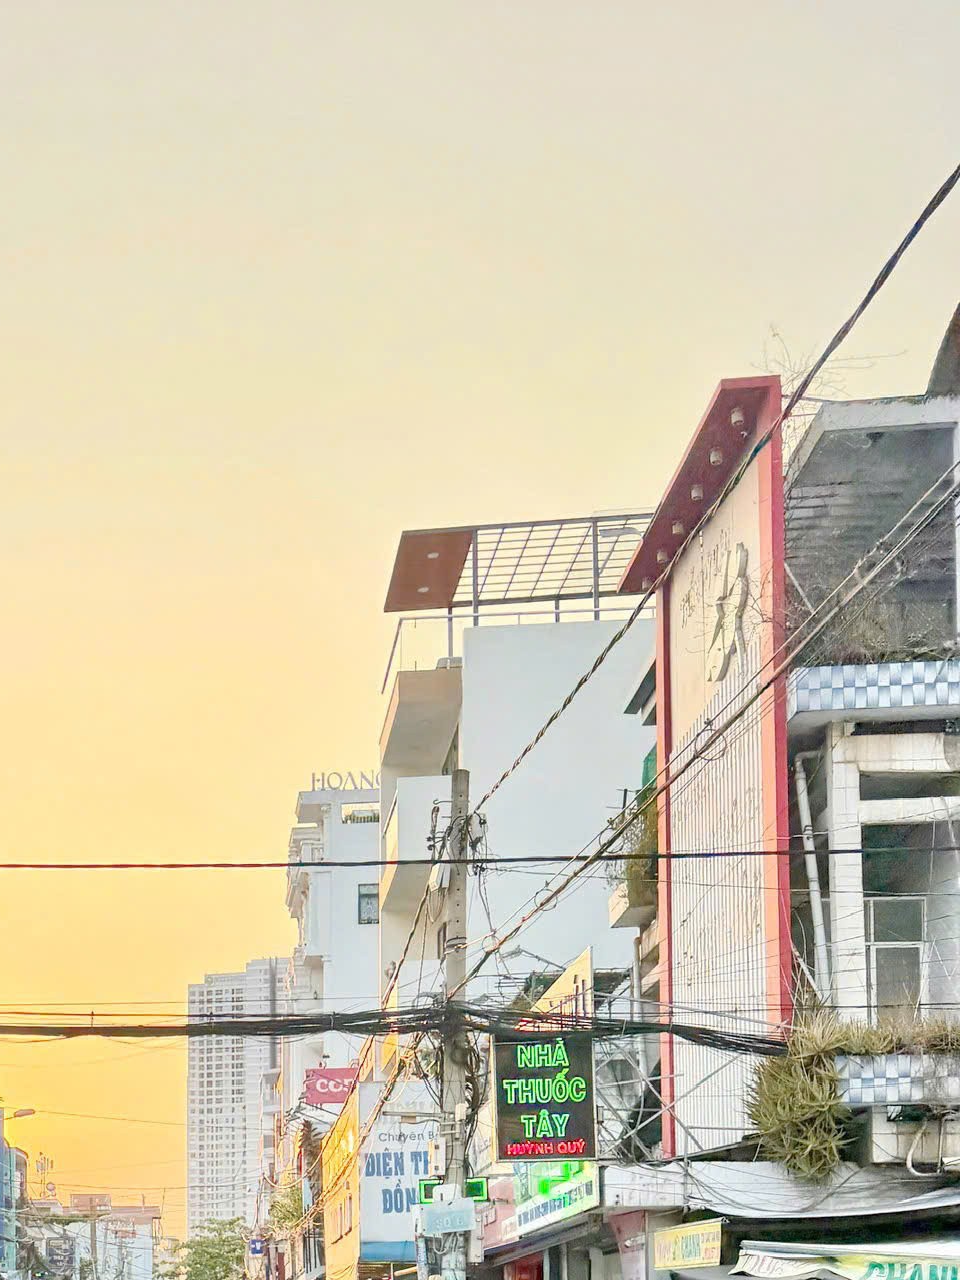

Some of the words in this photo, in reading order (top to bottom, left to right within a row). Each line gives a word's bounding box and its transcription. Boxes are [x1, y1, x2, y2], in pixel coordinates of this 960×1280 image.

[517, 1038, 569, 1068] NHÀ
[502, 1068, 587, 1104] THUỐC
[520, 1109, 570, 1138] TÂY
[507, 1141, 553, 1155] HUỲNH
[557, 1138, 585, 1154] QUÝ
[381, 1179, 416, 1213] ĐỒN
